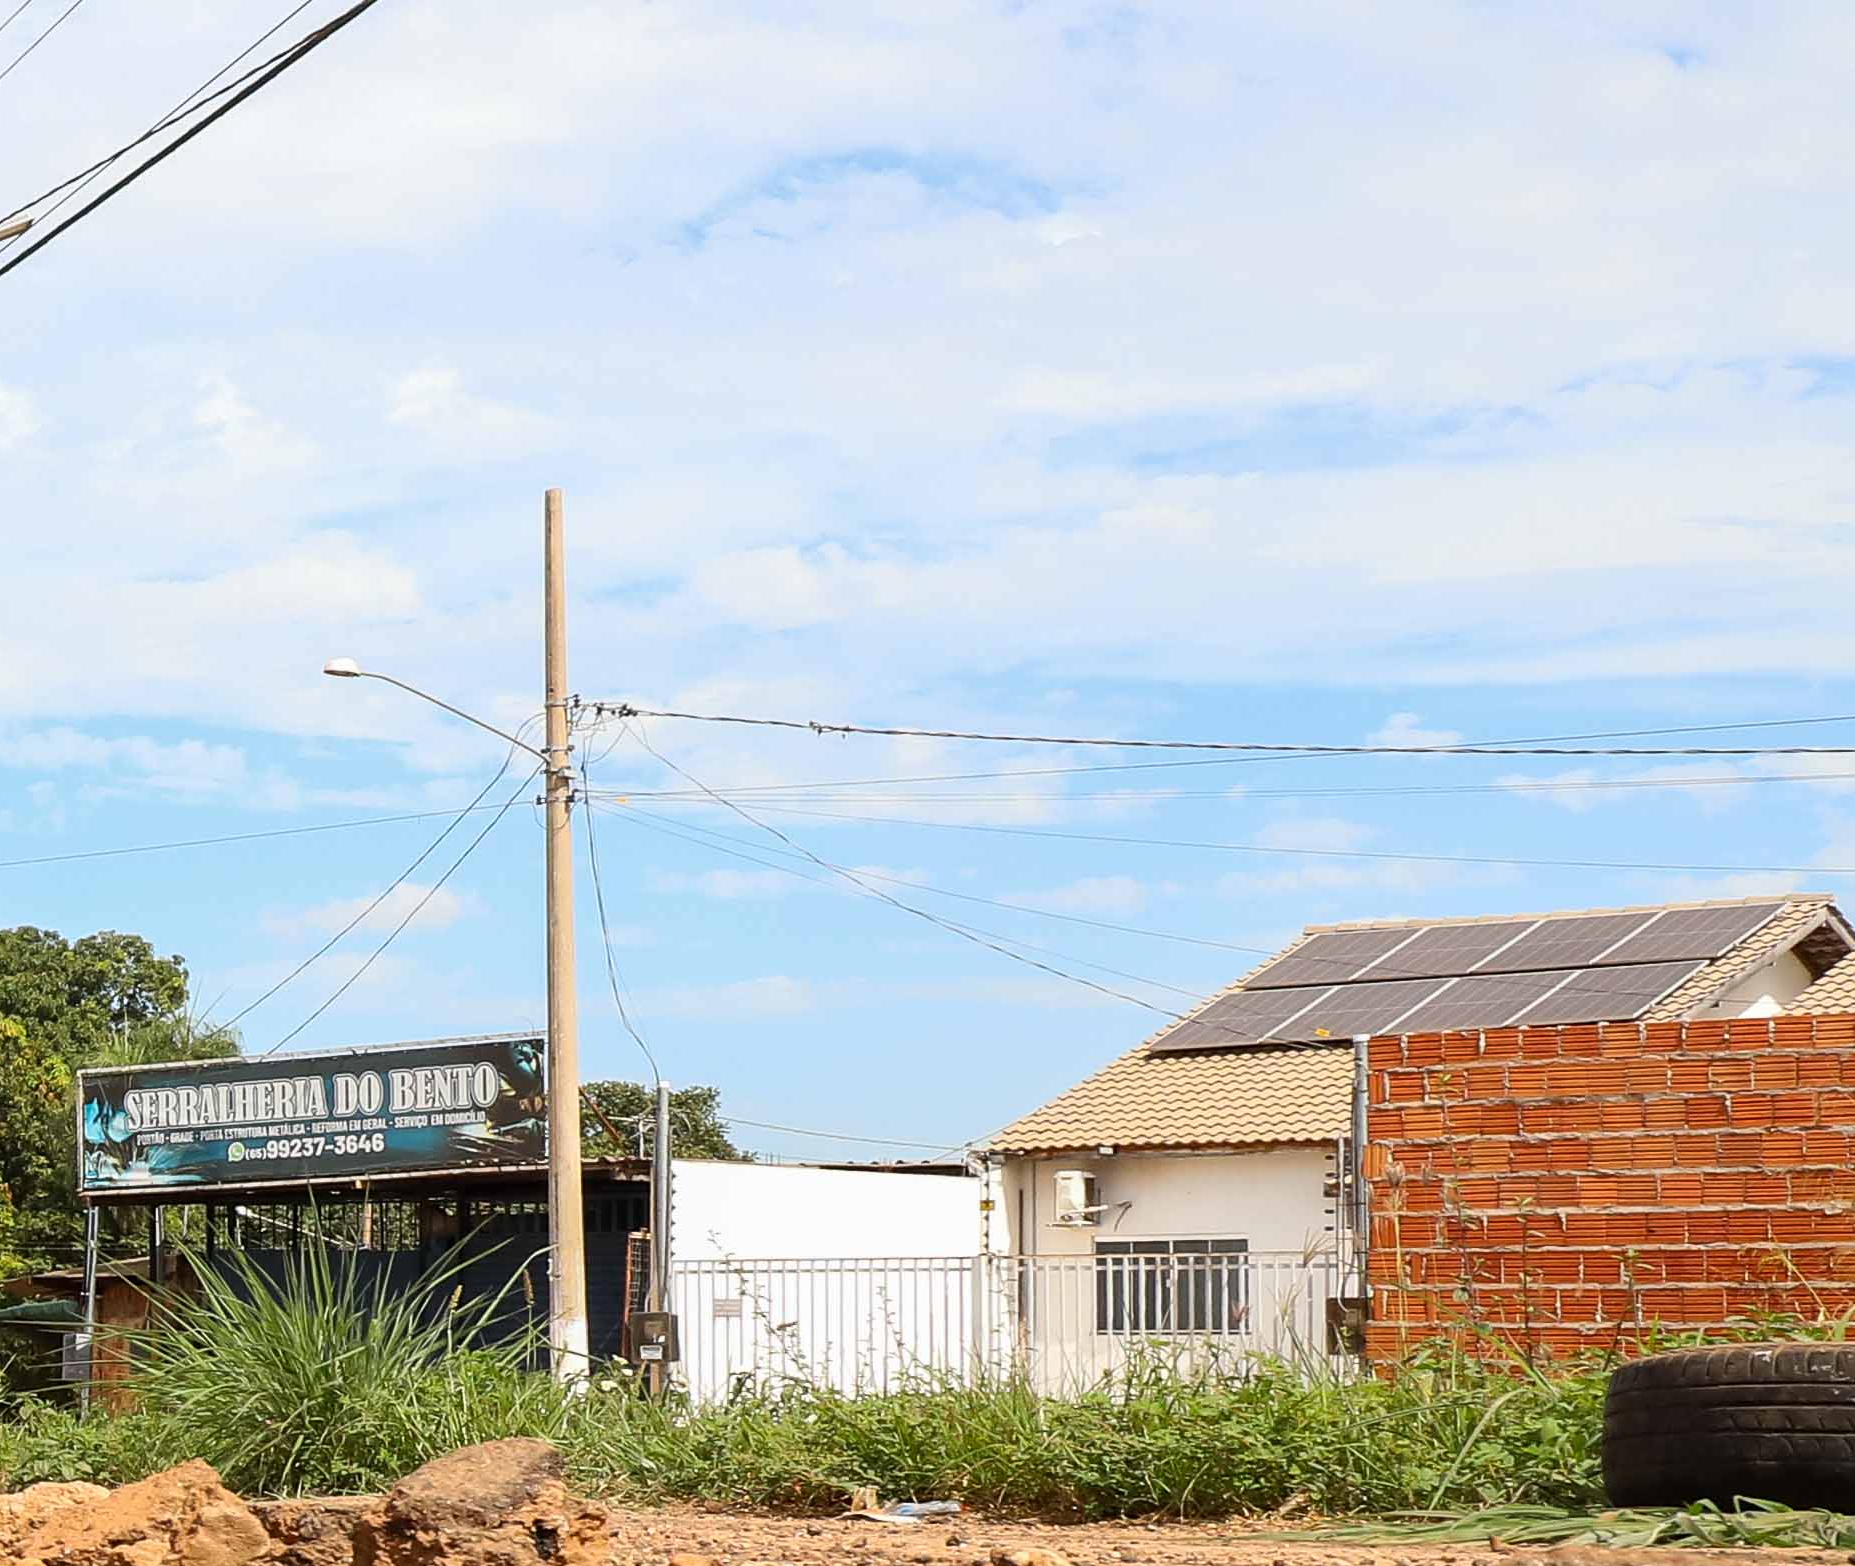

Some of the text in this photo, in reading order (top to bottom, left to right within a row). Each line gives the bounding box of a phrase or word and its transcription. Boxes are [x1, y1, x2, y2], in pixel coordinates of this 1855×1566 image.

[124, 1062, 499, 1132] SERRALHERIA DO BENTO
[224, 1126, 267, 1140] ESTRUTURA
[362, 1117, 387, 1130] GERAL
